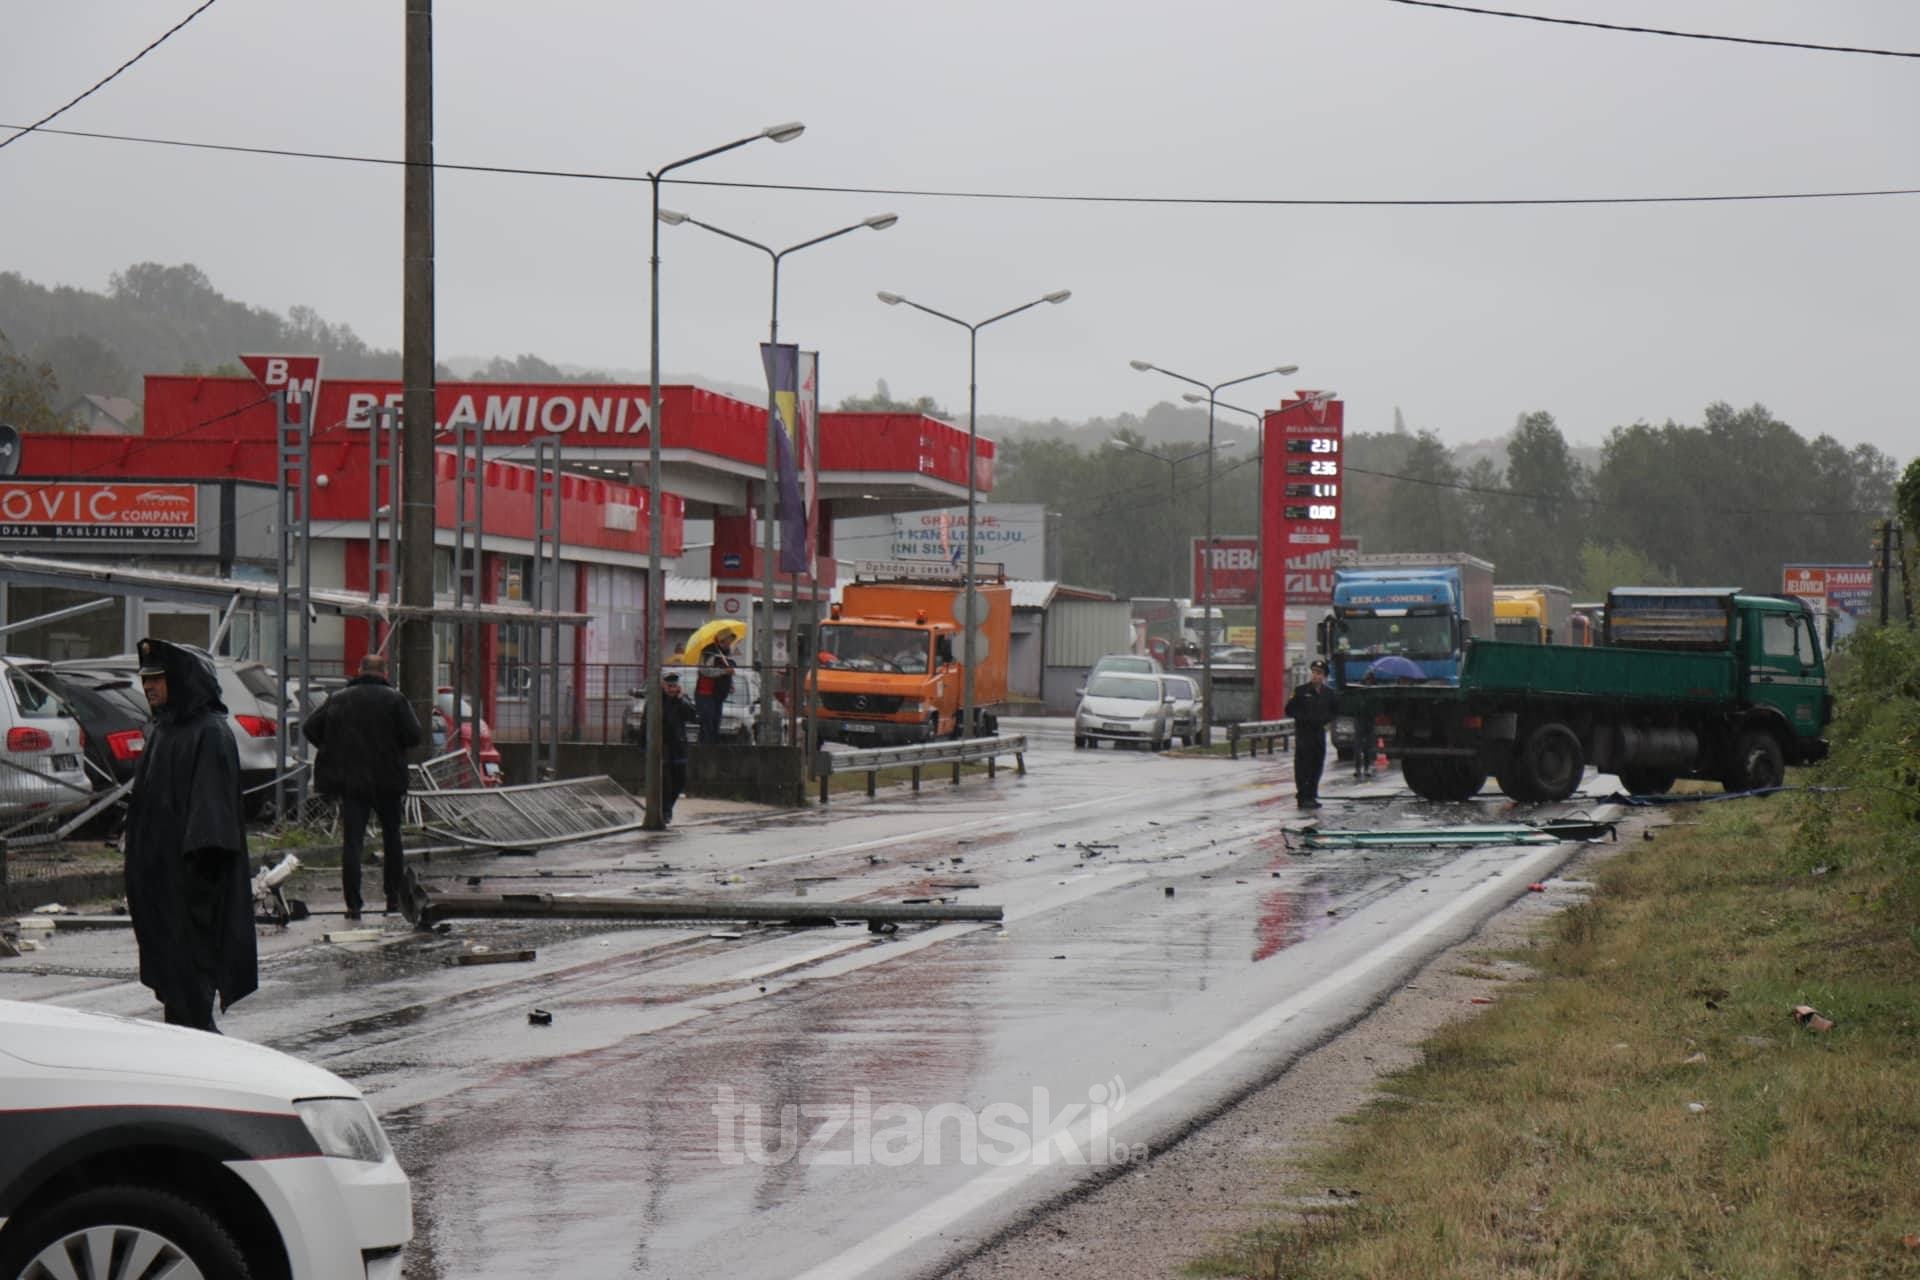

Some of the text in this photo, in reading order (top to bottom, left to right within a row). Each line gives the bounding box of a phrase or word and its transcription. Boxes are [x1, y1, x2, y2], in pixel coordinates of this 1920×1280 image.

[346, 393, 664, 433] BEAMIONIX
[121, 510, 189, 522] COMPANY
[56, 528, 135, 537] RABLJENIH
[142, 528, 195, 538] VOZILA
